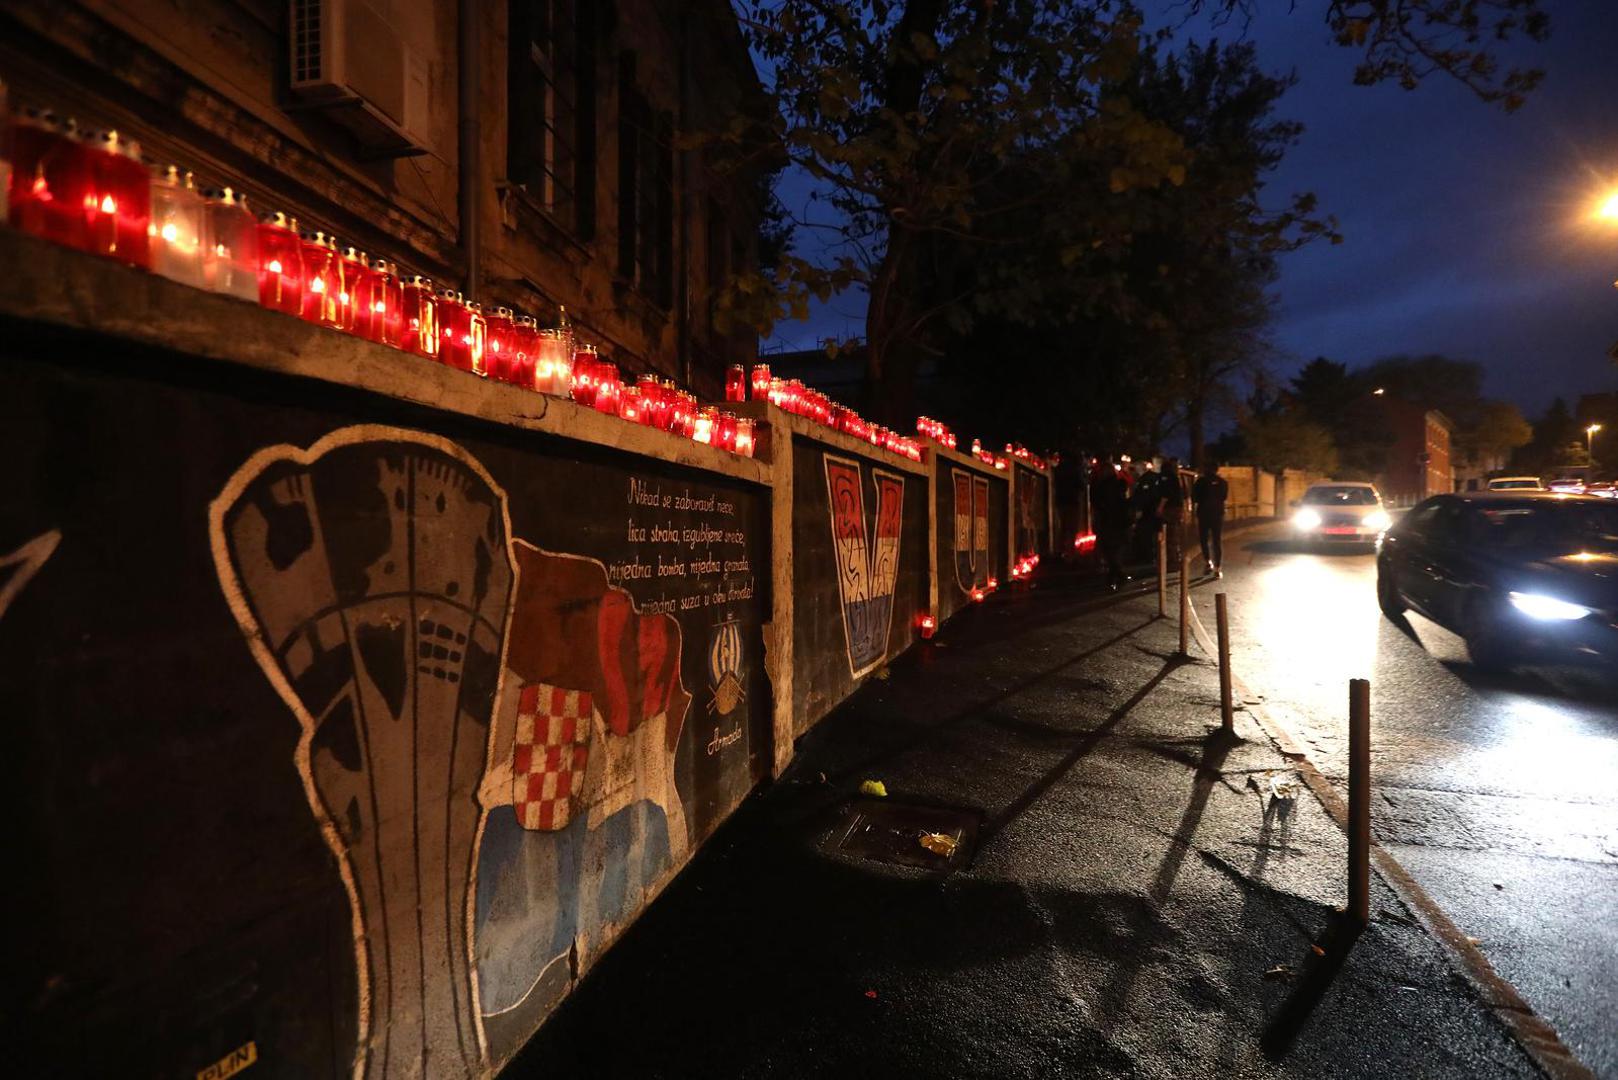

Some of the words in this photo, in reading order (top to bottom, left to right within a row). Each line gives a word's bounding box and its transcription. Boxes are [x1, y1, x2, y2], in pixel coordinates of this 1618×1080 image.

[662, 495, 672, 509] se
[628, 517, 646, 542] lica
[681, 595, 700, 610] suza
[704, 595, 710, 606] u
[203, 1047, 249, 1080] PLIN
